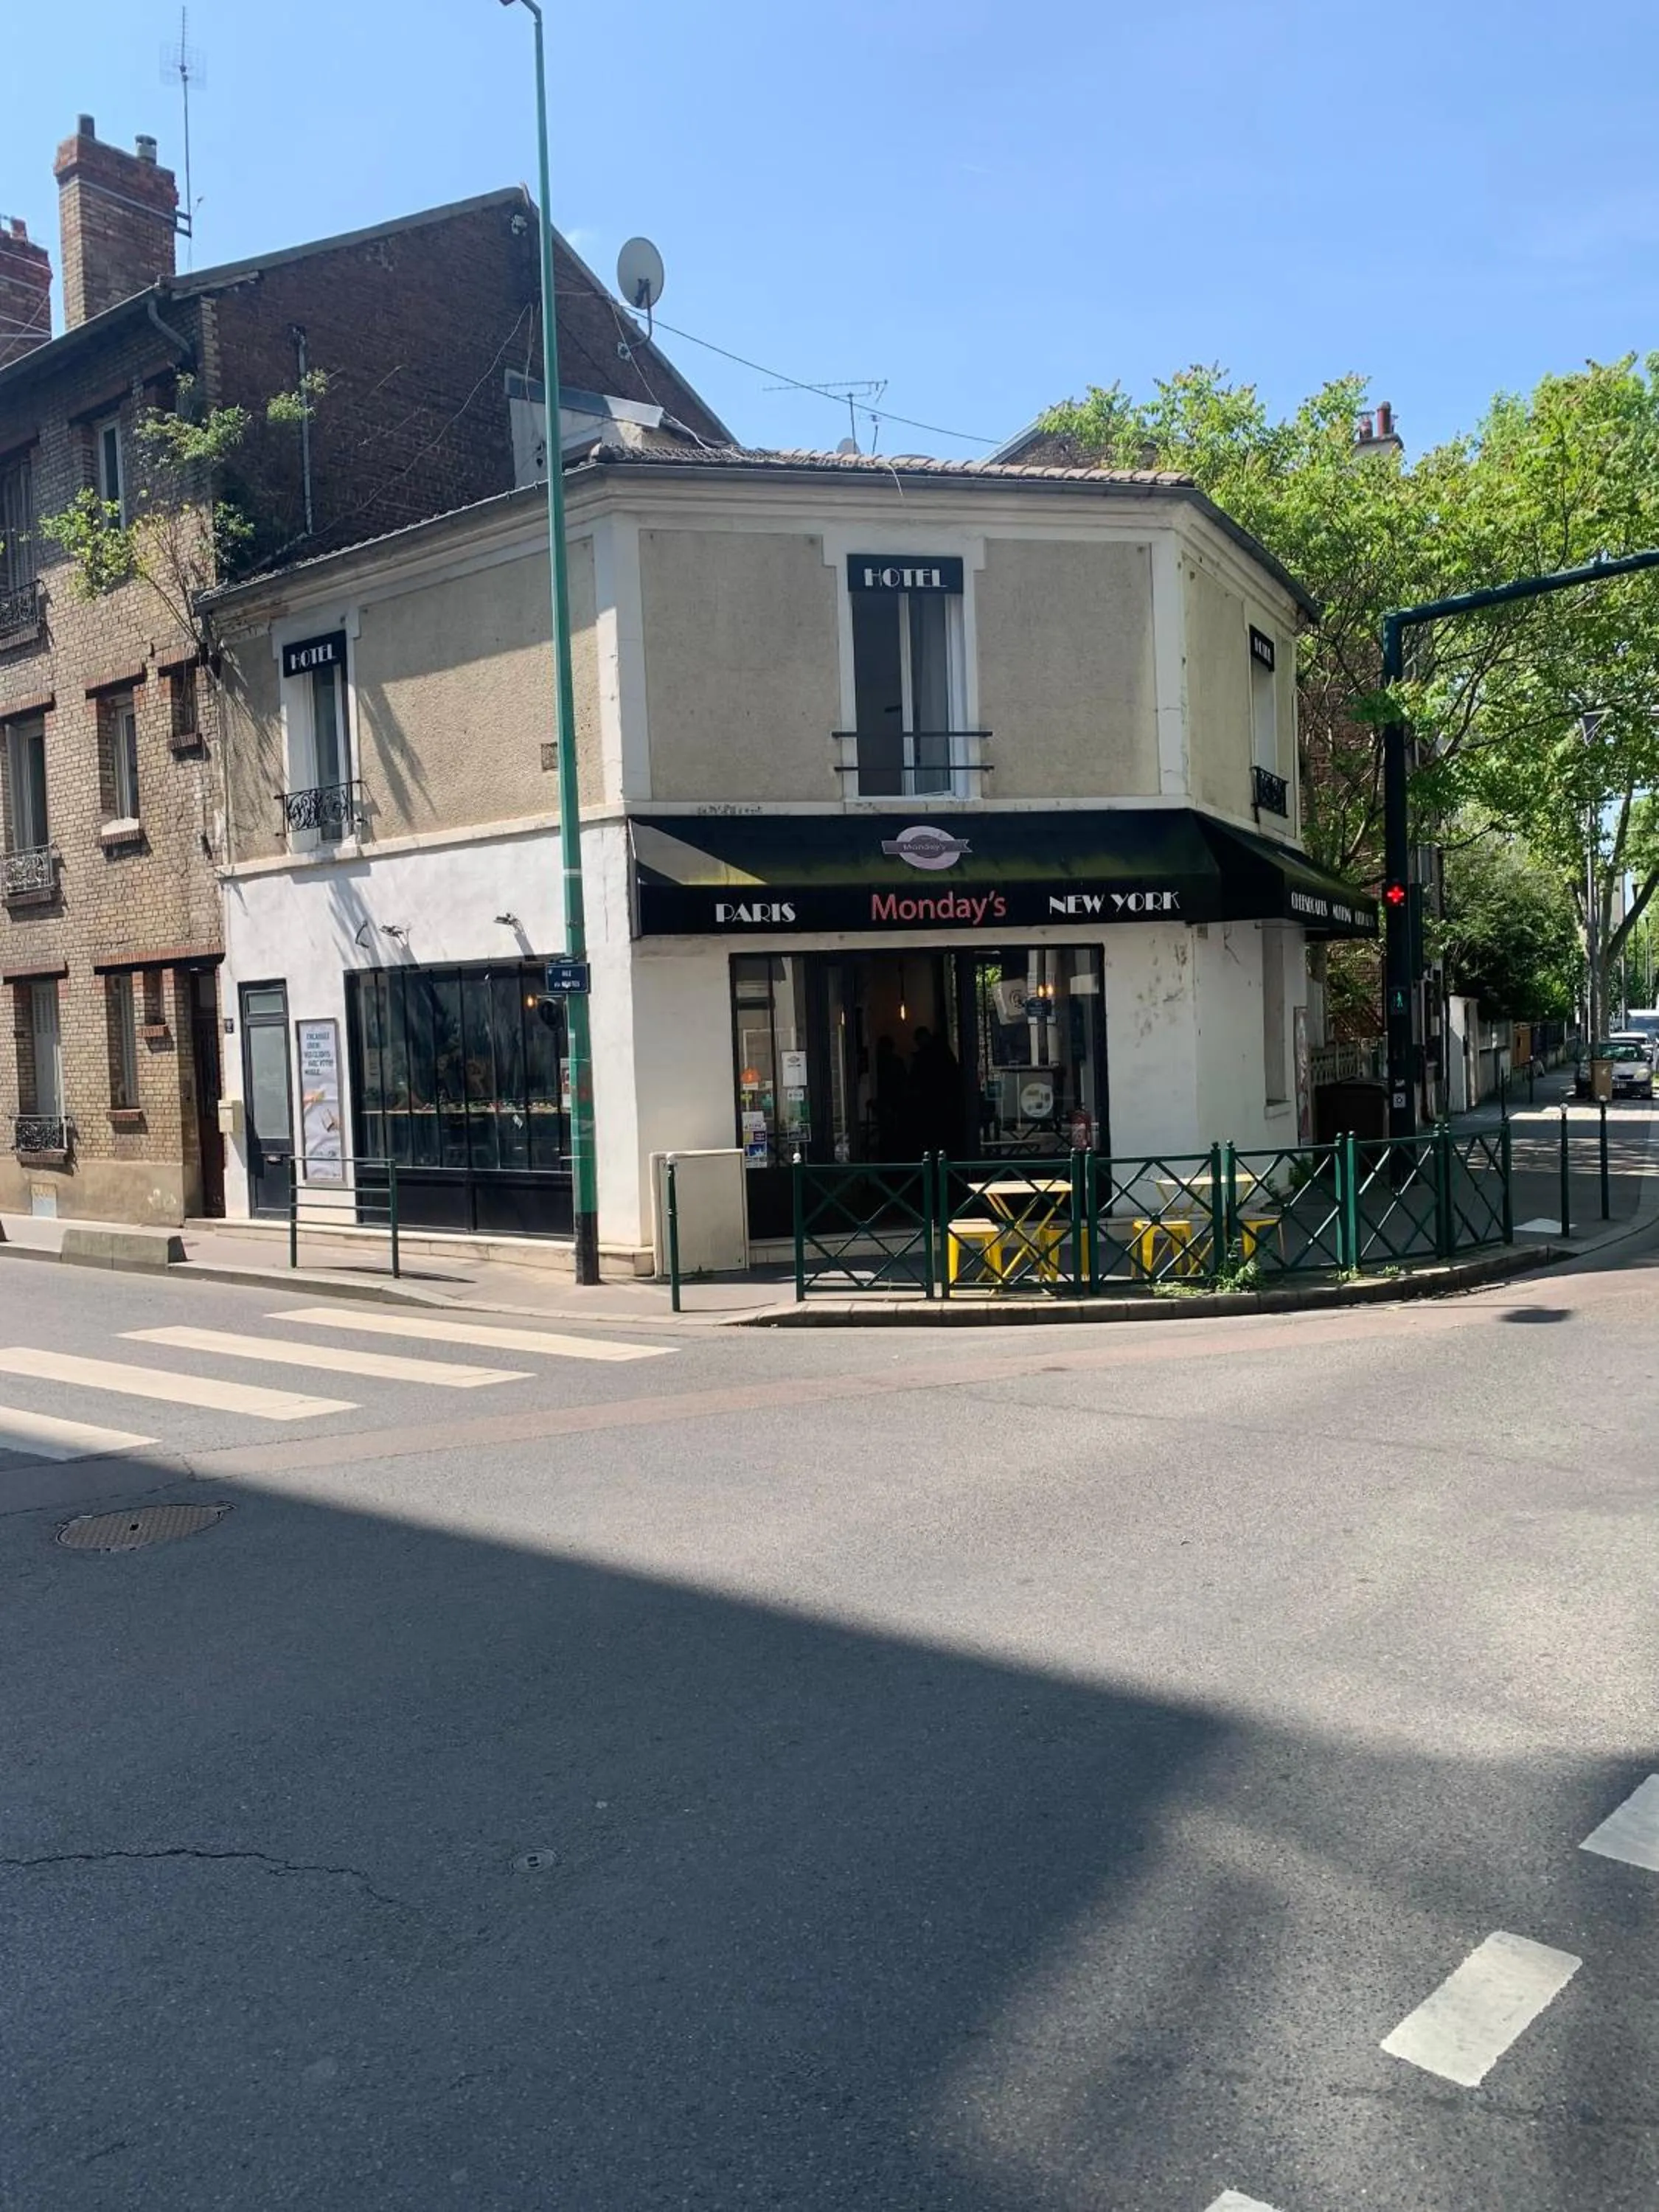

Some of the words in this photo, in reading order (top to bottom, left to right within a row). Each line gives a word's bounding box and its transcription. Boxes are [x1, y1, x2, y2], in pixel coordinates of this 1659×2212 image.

[863, 567, 948, 588] HOTEL
[291, 643, 336, 670] HOTEL
[714, 902, 796, 923] PARIS
[871, 890, 1006, 926] Monday's
[1048, 894, 1105, 914] NEW
[1110, 891, 1180, 911] YORK
